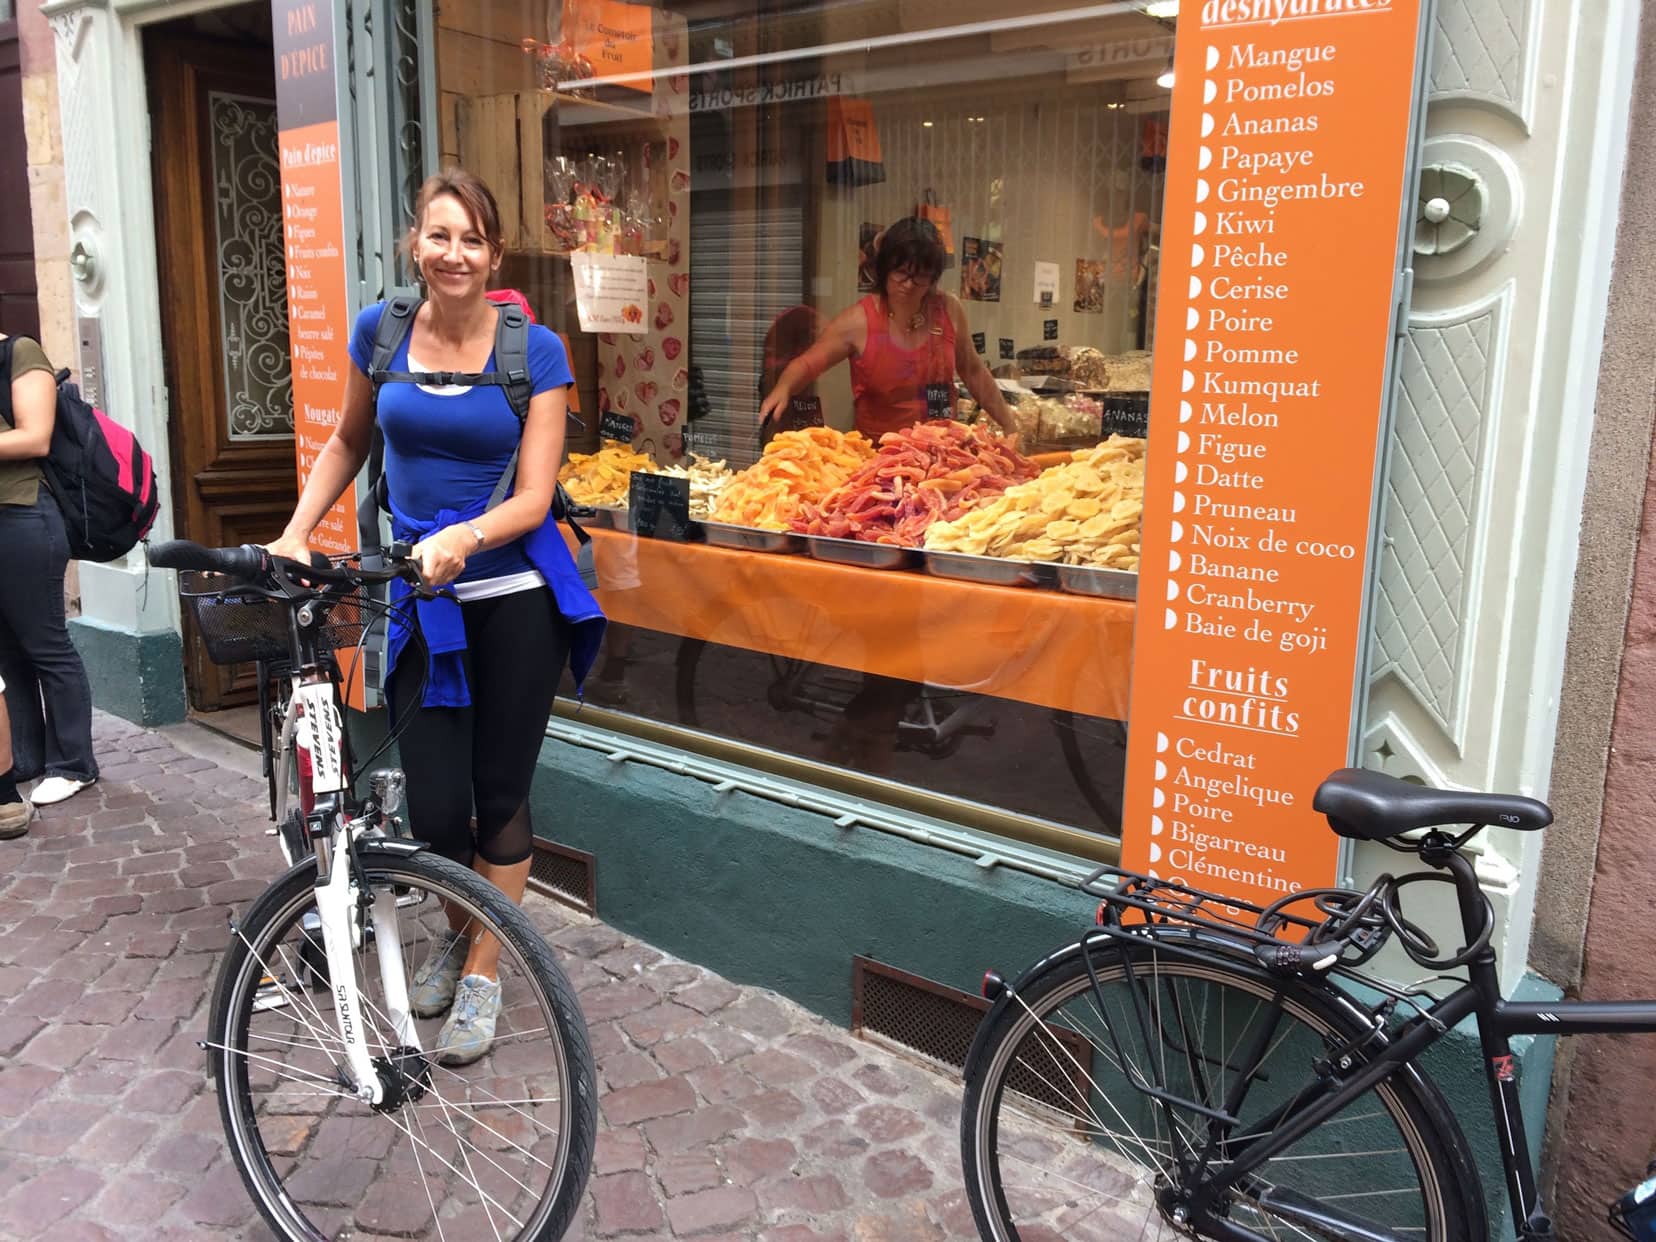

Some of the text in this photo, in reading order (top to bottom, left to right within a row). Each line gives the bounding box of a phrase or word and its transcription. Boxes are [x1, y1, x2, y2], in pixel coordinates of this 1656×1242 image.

[288, 4, 317, 38] PAIN
[1227, 44, 1336, 71] Mangue
[1225, 72, 1335, 103] Pomelos
[1221, 112, 1319, 137] Ananas
[283, 147, 303, 169] Pain
[1220, 146, 1314, 175] Papaye
[1217, 173, 1365, 207] Gingembre
[1215, 211, 1275, 235] Kiwi
[1213, 243, 1288, 267] Pêche
[1209, 276, 1289, 300] Cerise
[1207, 309, 1273, 332] Poire
[1205, 340, 1299, 364] Pomme
[1203, 372, 1321, 402] Kumquat
[304, 403, 341, 426] Nougats
[1200, 403, 1279, 427] Melon
[1198, 433, 1267, 463] Figue
[1196, 464, 1264, 489] Datte
[1193, 494, 1296, 523] Pruneau
[1191, 524, 1356, 560] Noix de coco
[1188, 553, 1280, 583] Banane
[1186, 583, 1315, 619] Cranberry
[1185, 612, 1327, 654] Baie de goji
[1190, 659, 1289, 697] Fruits
[1182, 695, 1300, 733] confits
[306, 698, 326, 780] STEVENS
[320, 696, 340, 777] STEVENS
[1175, 737, 1256, 770] Cedrat
[1173, 765, 1295, 807] Angelique
[1173, 793, 1233, 823] Poire
[1170, 820, 1287, 863] Bigarreau
[1168, 848, 1302, 894] Clémentine
